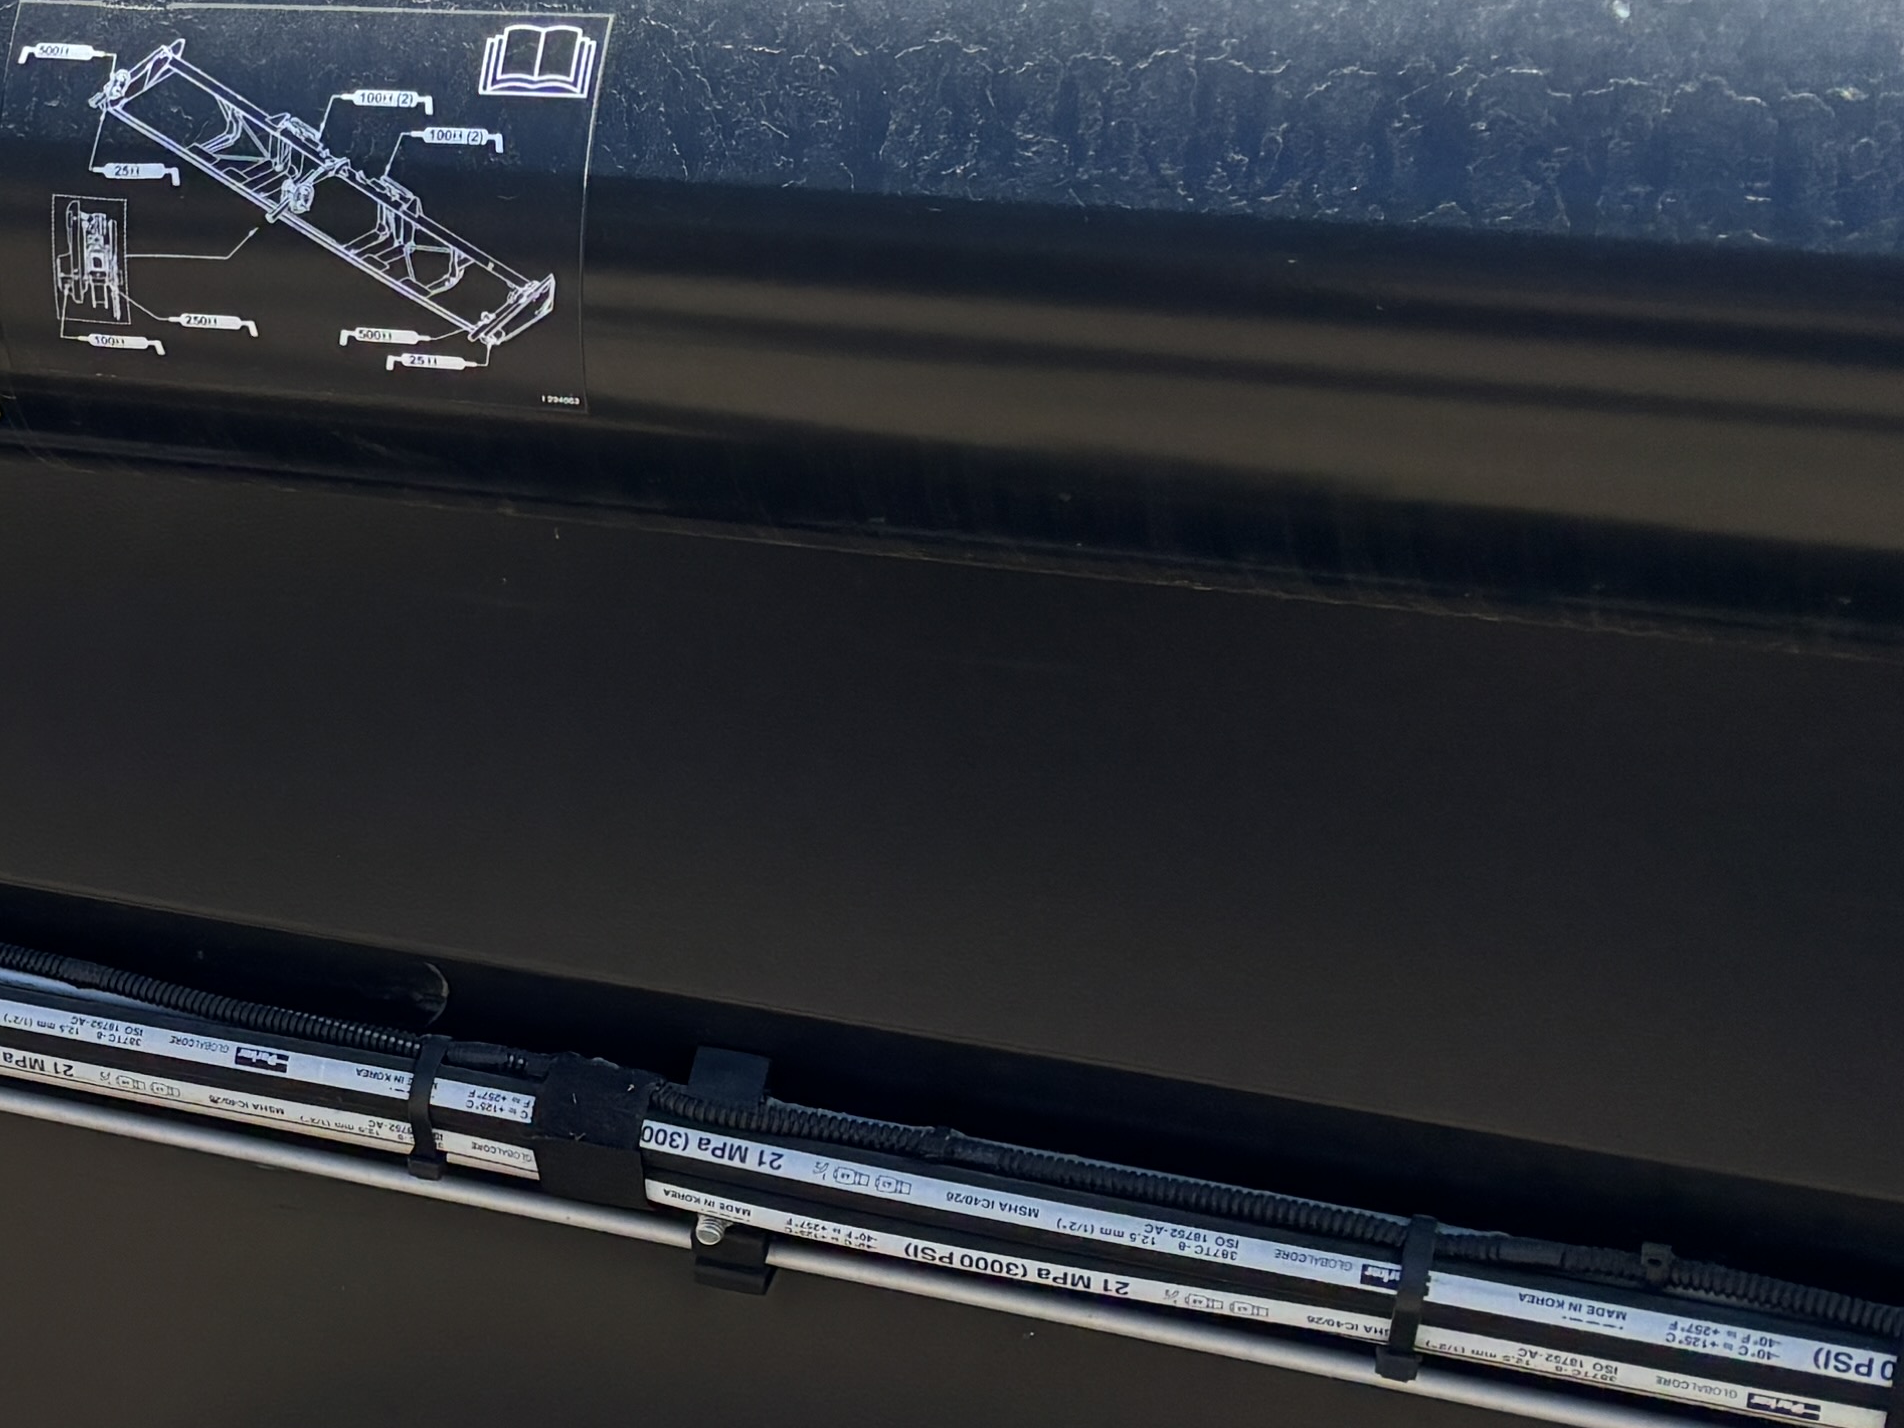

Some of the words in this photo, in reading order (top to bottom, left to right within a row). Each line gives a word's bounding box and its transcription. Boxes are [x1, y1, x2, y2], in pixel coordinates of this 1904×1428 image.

[36, 1018, 57, 1029] mm
[123, 1024, 144, 1037] ISO
[50, 1060, 75, 1077] 21
[353, 1066, 391, 1083] KOREA
[638, 1122, 691, 1152] (300
[694, 1134, 750, 1164] MPa
[754, 1148, 784, 1171] 21
[660, 1186, 702, 1204] KOREA
[717, 1199, 752, 1216] MADE
[997, 1200, 1040, 1219] MSHA
[1098, 1225, 1125, 1238] mm
[1213, 1234, 1240, 1250] ISO
[901, 1240, 955, 1266] PSI)
[1272, 1246, 1353, 1272] GLOBALCORE
[957, 1250, 1029, 1281] (3000
[1034, 1264, 1093, 1291] MPa
[1100, 1276, 1131, 1296] 21
[1516, 1290, 1565, 1311] KOREA
[1566, 1300, 1583, 1314] IN
[1585, 1303, 1627, 1322] MADE
[1591, 1360, 1619, 1375] ISO
[1809, 1344, 1875, 1379] PSI)
[1653, 1373, 1738, 1400] GLOBALCORE
